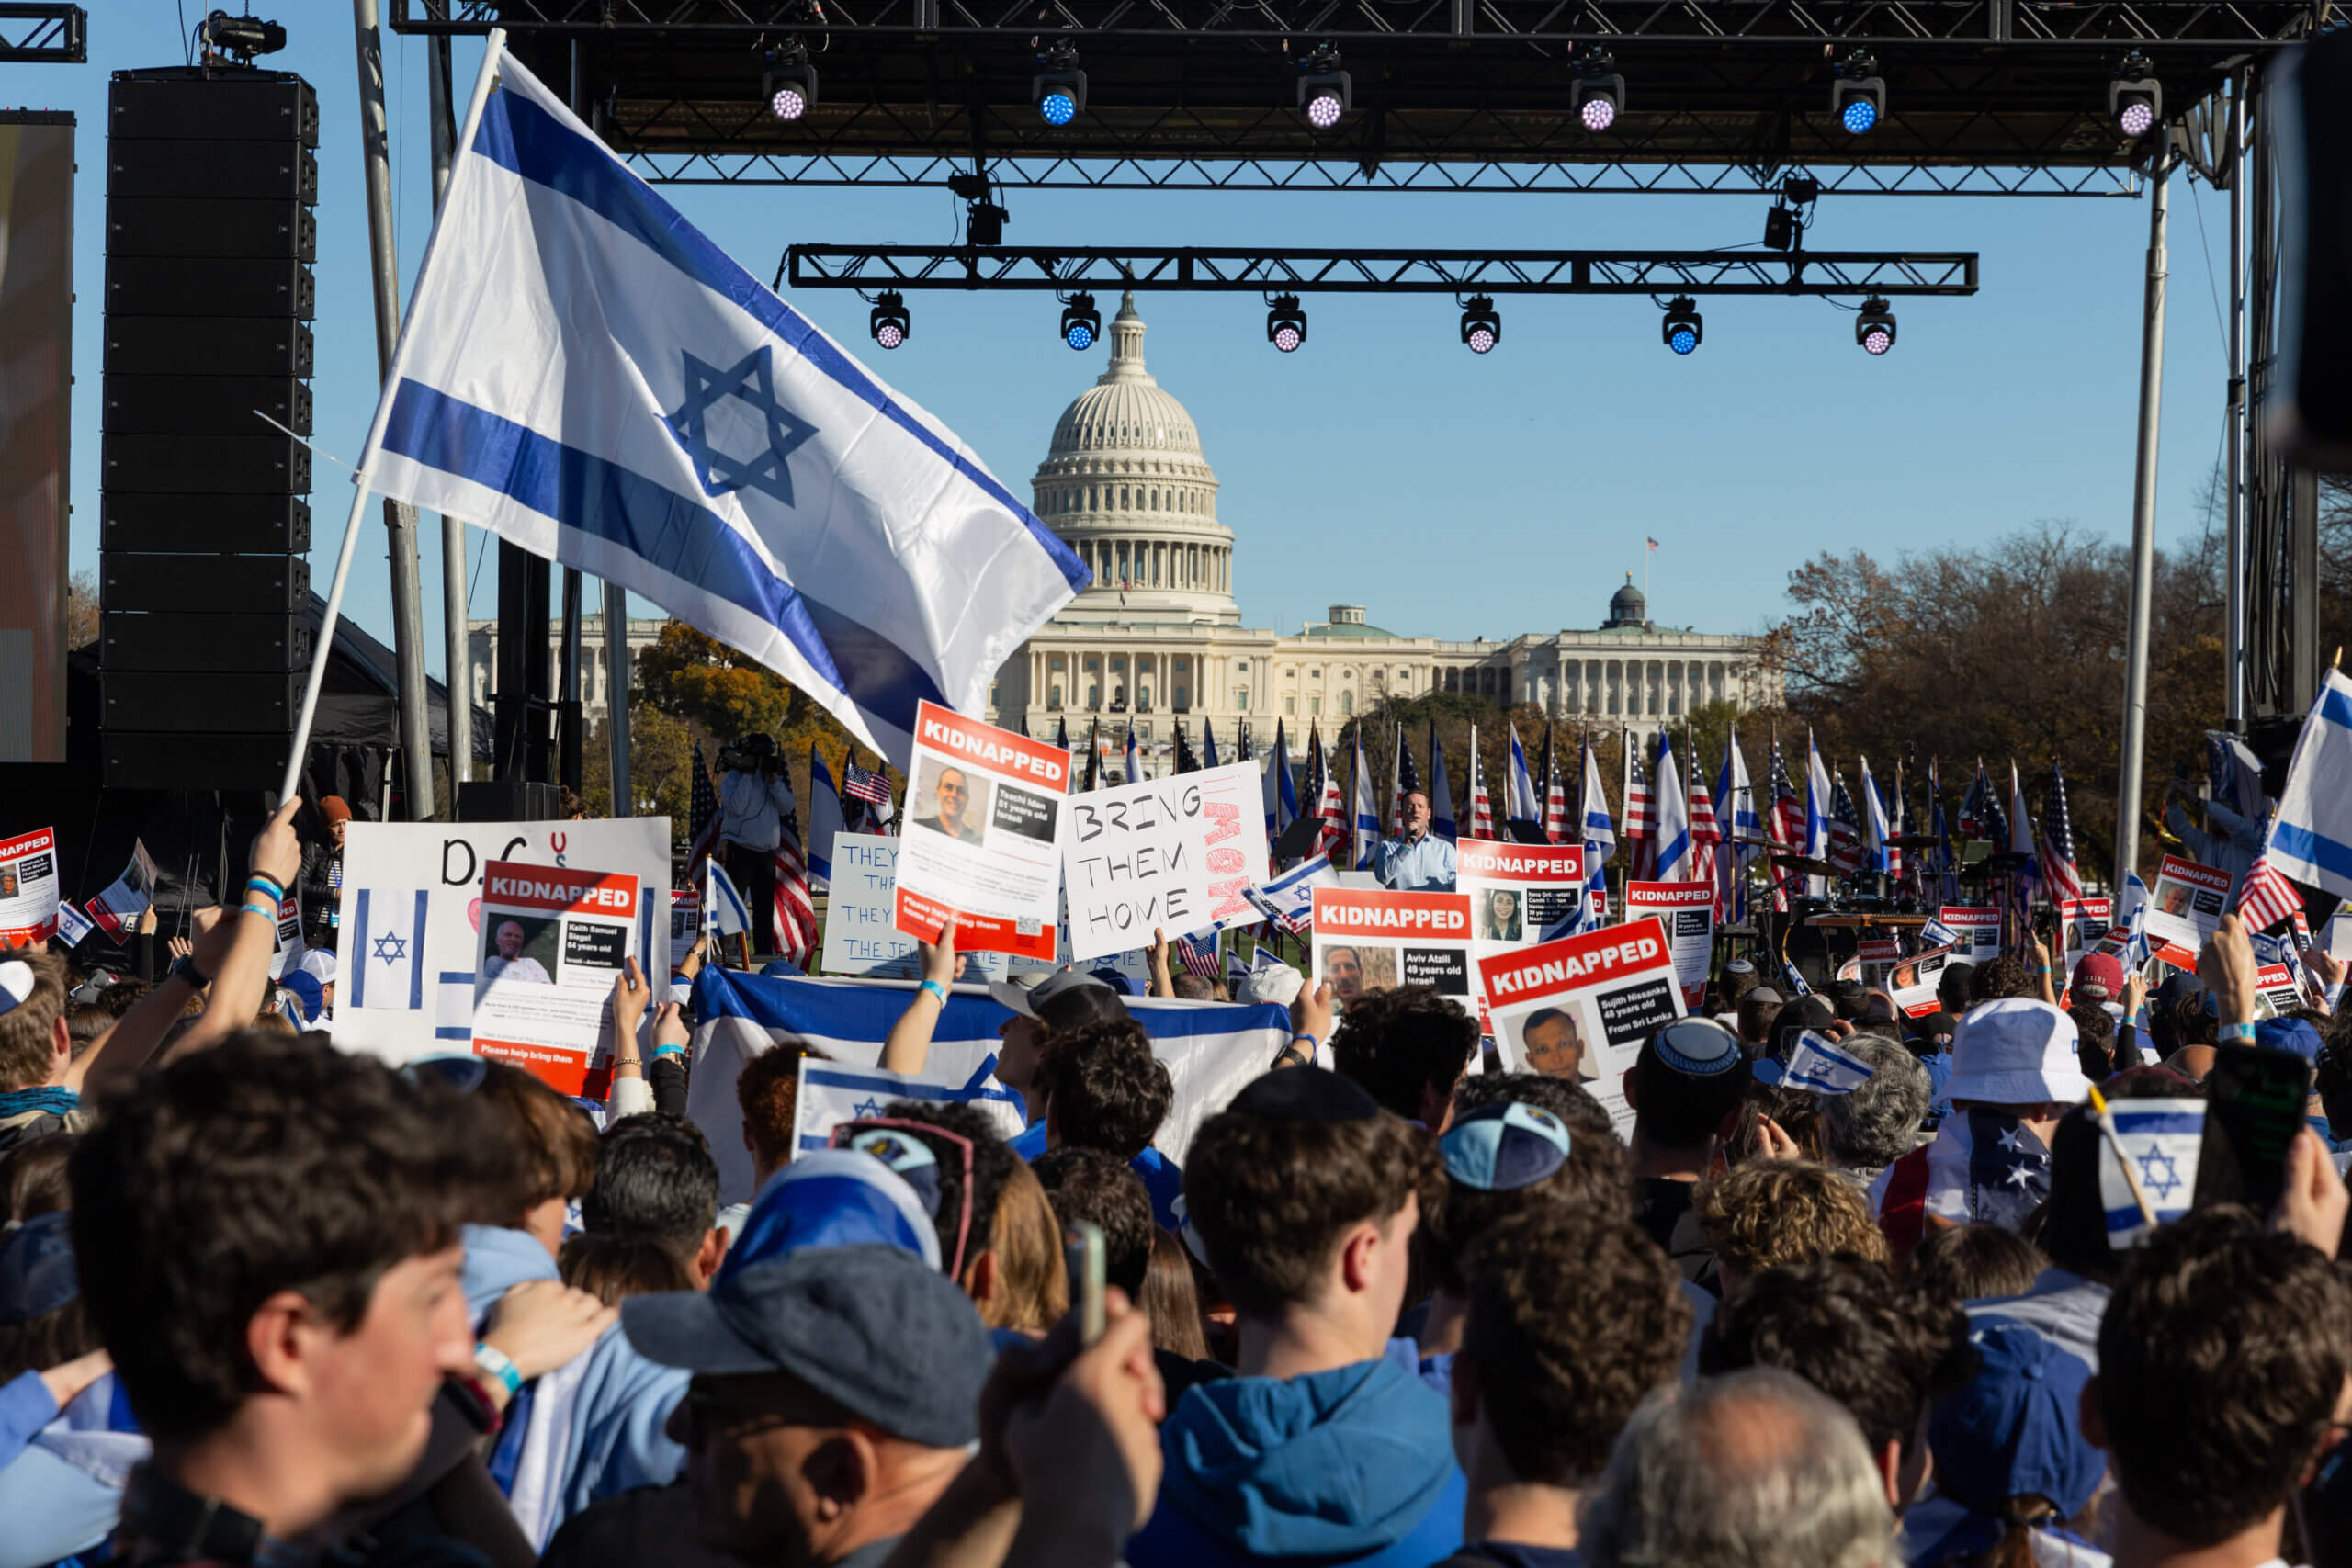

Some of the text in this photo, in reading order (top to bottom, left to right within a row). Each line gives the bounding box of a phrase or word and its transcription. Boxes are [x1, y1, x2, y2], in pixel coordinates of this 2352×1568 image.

[924, 718, 1062, 782] KIDNAPPED
[1010, 805, 1032, 817] years
[1034, 811, 1048, 821] old
[1074, 785, 1201, 842] BRING
[841, 845, 899, 868] THEY
[1077, 841, 1189, 889] THEM
[1464, 853, 1577, 874] KIDNAPPED
[2165, 863, 2228, 888] KIDNAPPED
[491, 877, 630, 908] KIDNAPPED
[1631, 889, 1711, 901] KIDNAPPED
[841, 905, 891, 924] THEY
[903, 895, 930, 912] Please
[976, 919, 1001, 931] them
[1087, 887, 1189, 934] HOME
[1321, 905, 1464, 930] KIDNAPPED
[1943, 913, 1998, 922] KIDNAPPED
[577, 943, 598, 952] years
[599, 944, 612, 953] old
[842, 939, 882, 958] THE
[1406, 953, 1451, 964] Aviv Atzili
[1407, 965, 1462, 976] 49 years old
[1491, 937, 1658, 996] KIDNAPPED
[1407, 976, 1435, 986] Israeli
[1601, 986, 1668, 1010] Sujith Nissanka
[1616, 1005, 1640, 1019] years
[1641, 999, 1656, 1010] old
[1608, 1011, 1673, 1035] From Sri Lanka
[481, 1044, 573, 1064] Please help bring them
